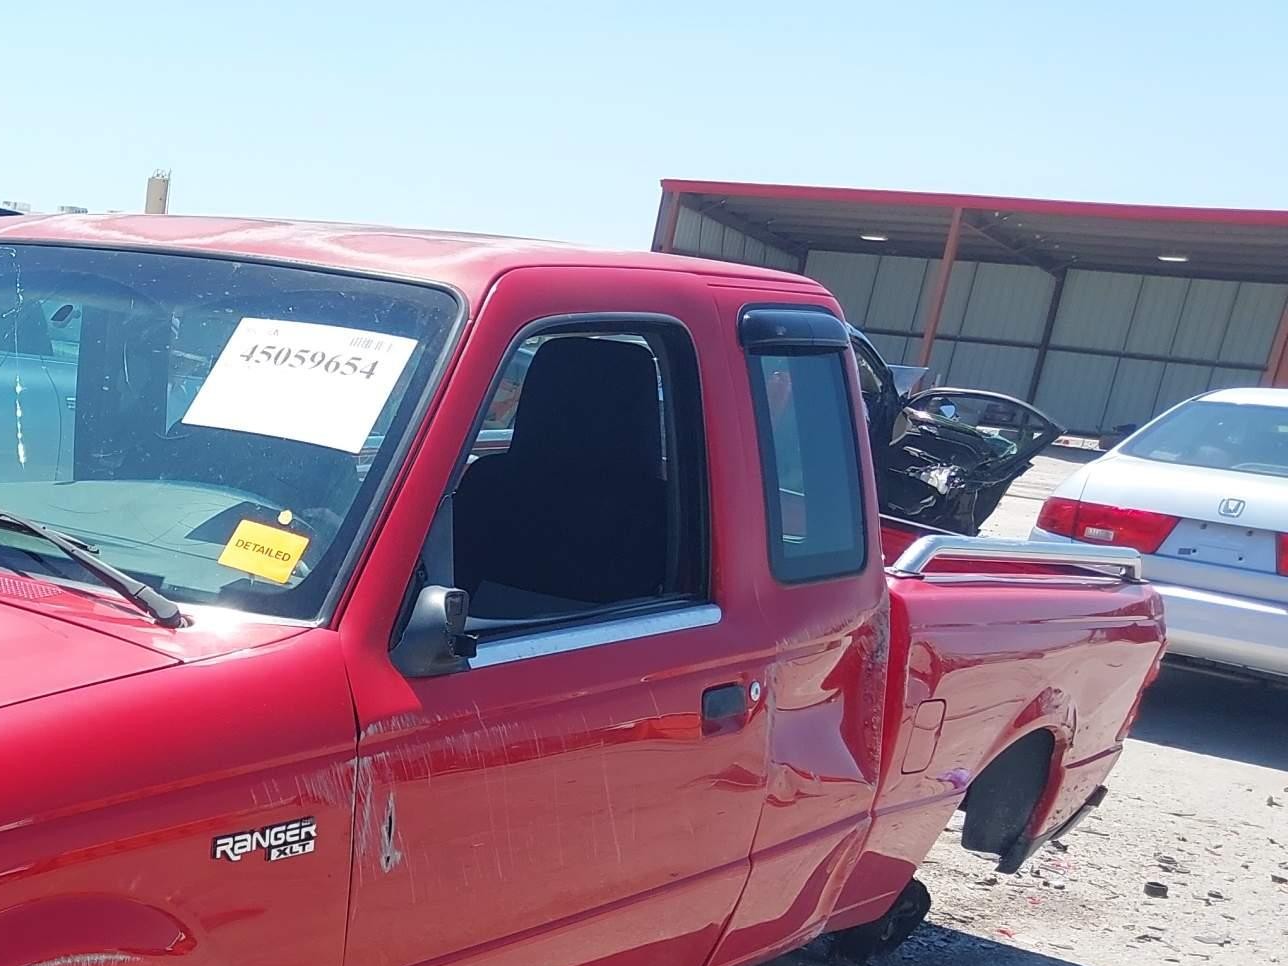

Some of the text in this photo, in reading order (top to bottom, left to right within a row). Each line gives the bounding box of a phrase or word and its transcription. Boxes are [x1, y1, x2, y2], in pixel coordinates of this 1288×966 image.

[239, 343, 380, 379] 45059654
[234, 538, 292, 563] DETAILED
[273, 841, 313, 860] XLT
